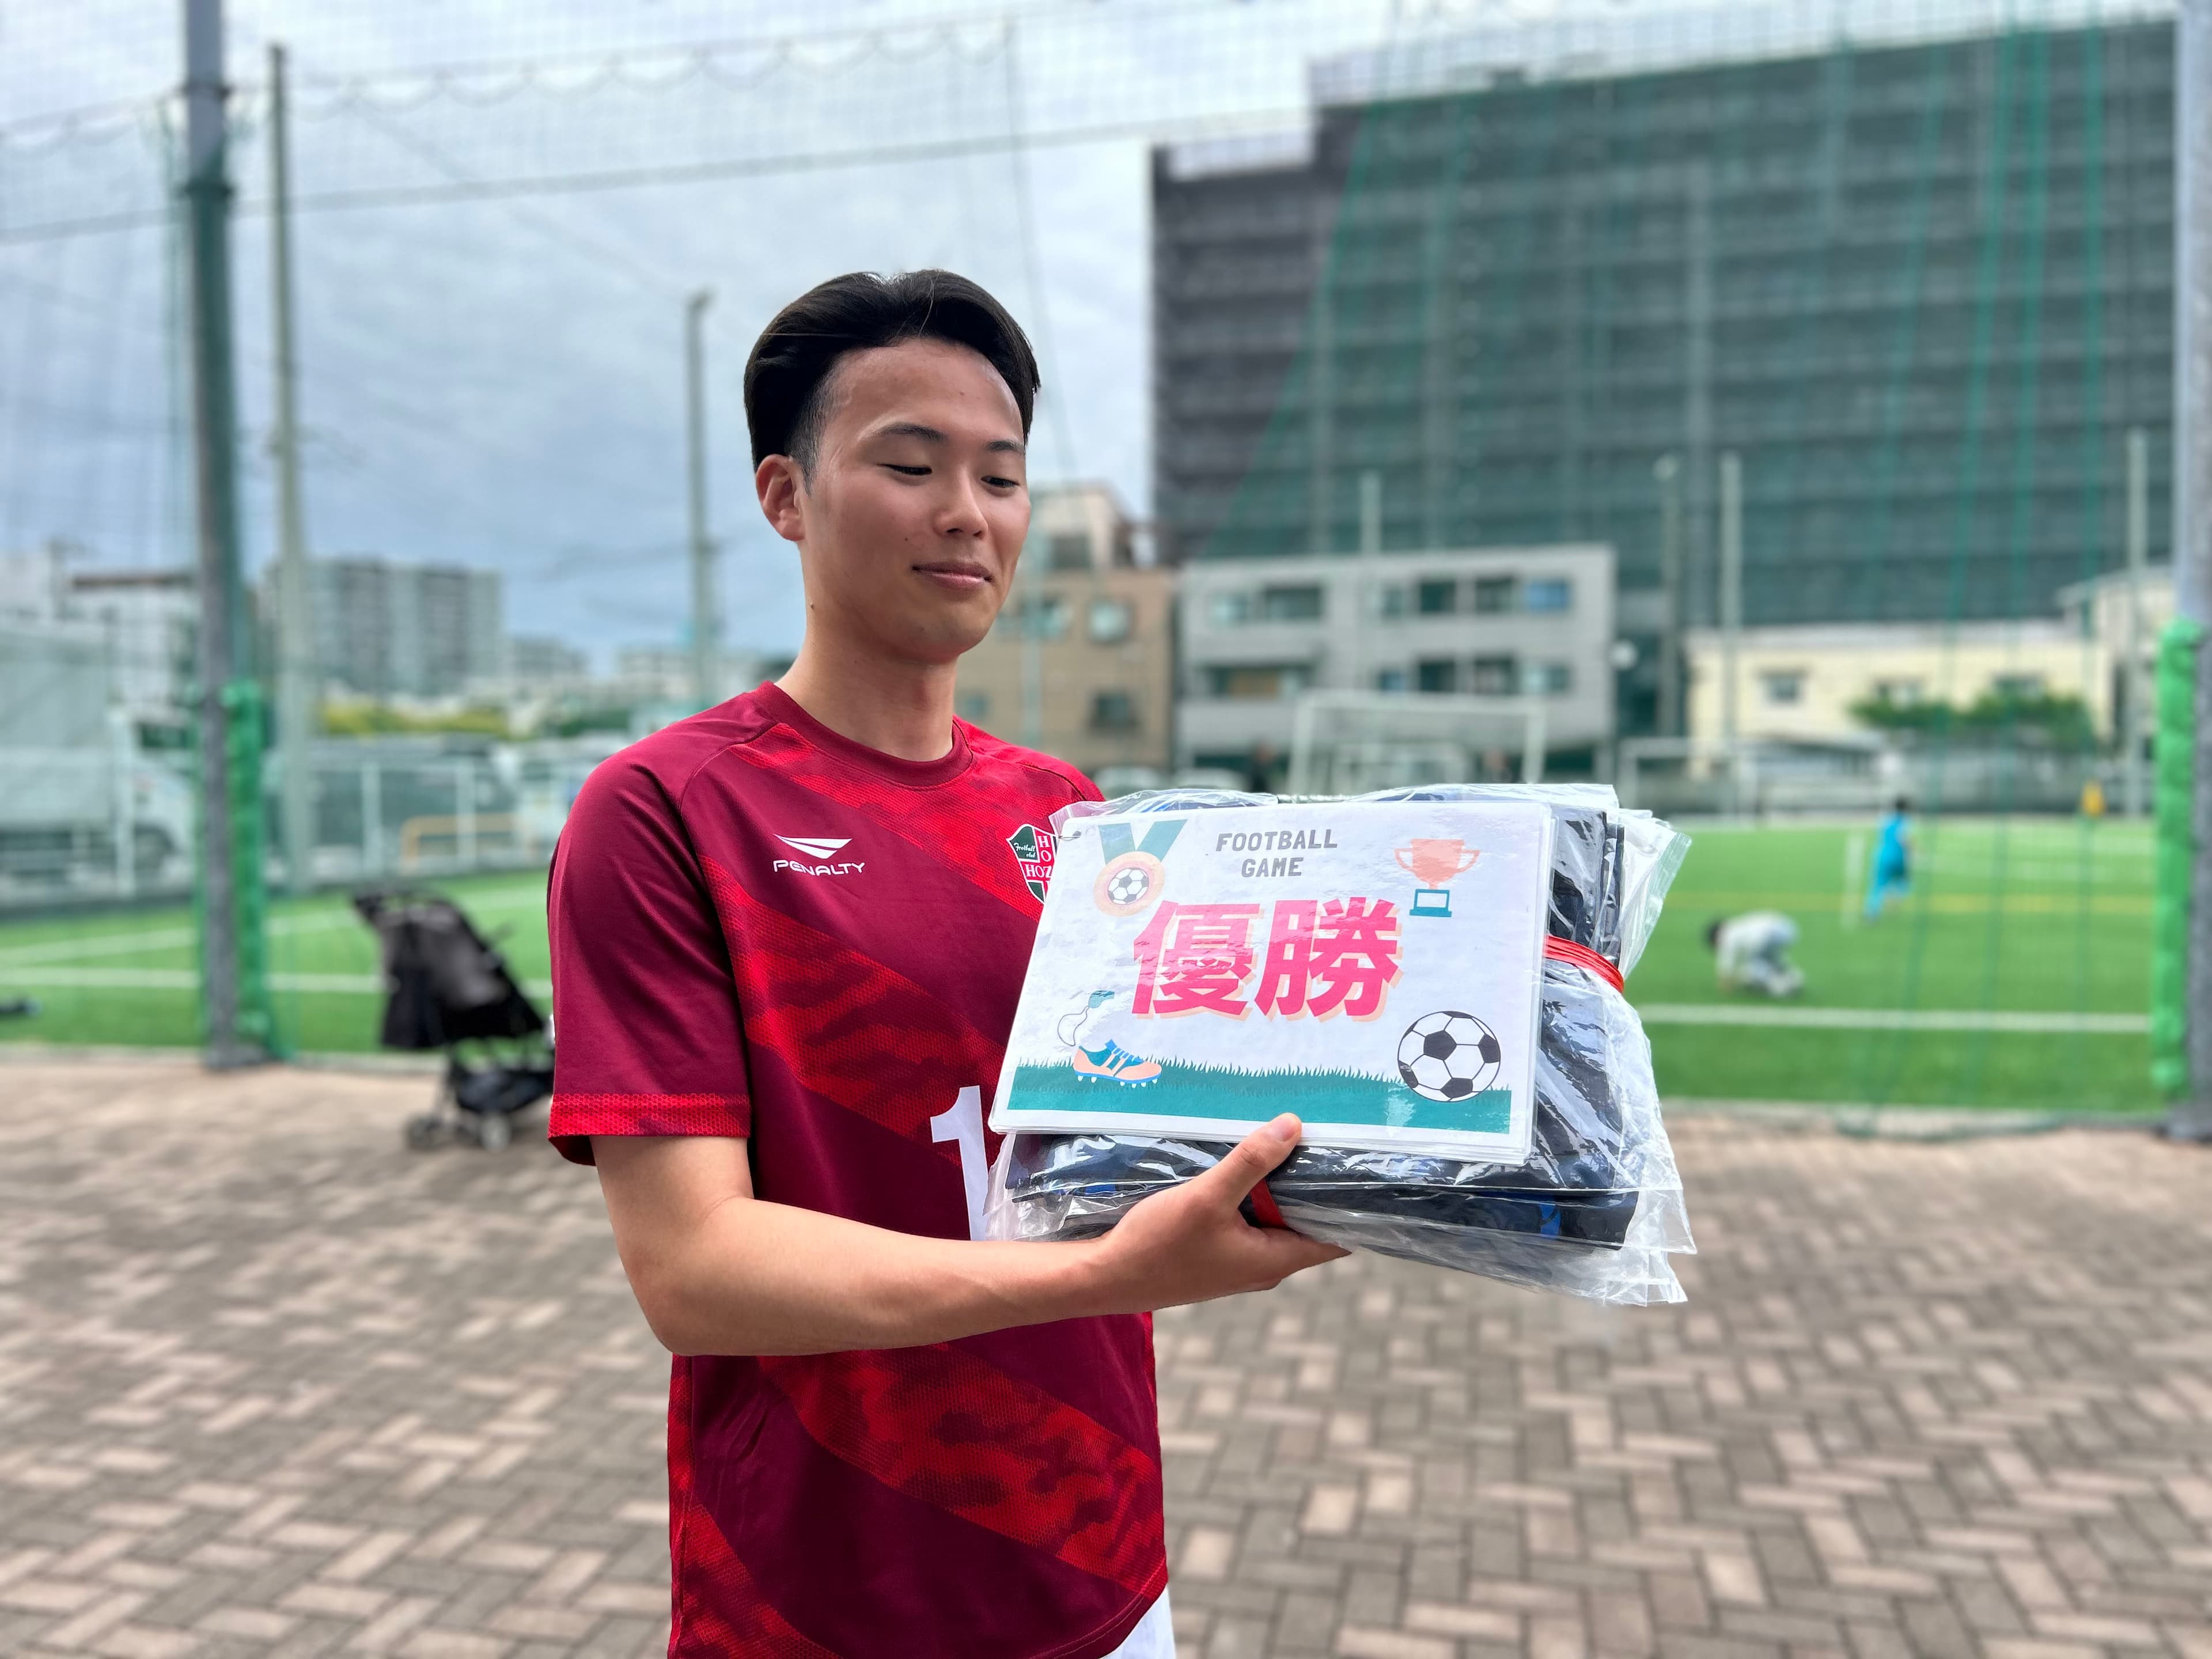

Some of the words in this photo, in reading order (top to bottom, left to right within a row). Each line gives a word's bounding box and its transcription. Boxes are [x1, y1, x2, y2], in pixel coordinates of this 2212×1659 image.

[1215, 829, 1338, 852] FOOTBALL
[773, 859, 865, 876] PENALTY
[1241, 857, 1304, 878] GAME
[1131, 896, 1402, 1020] 優勝
